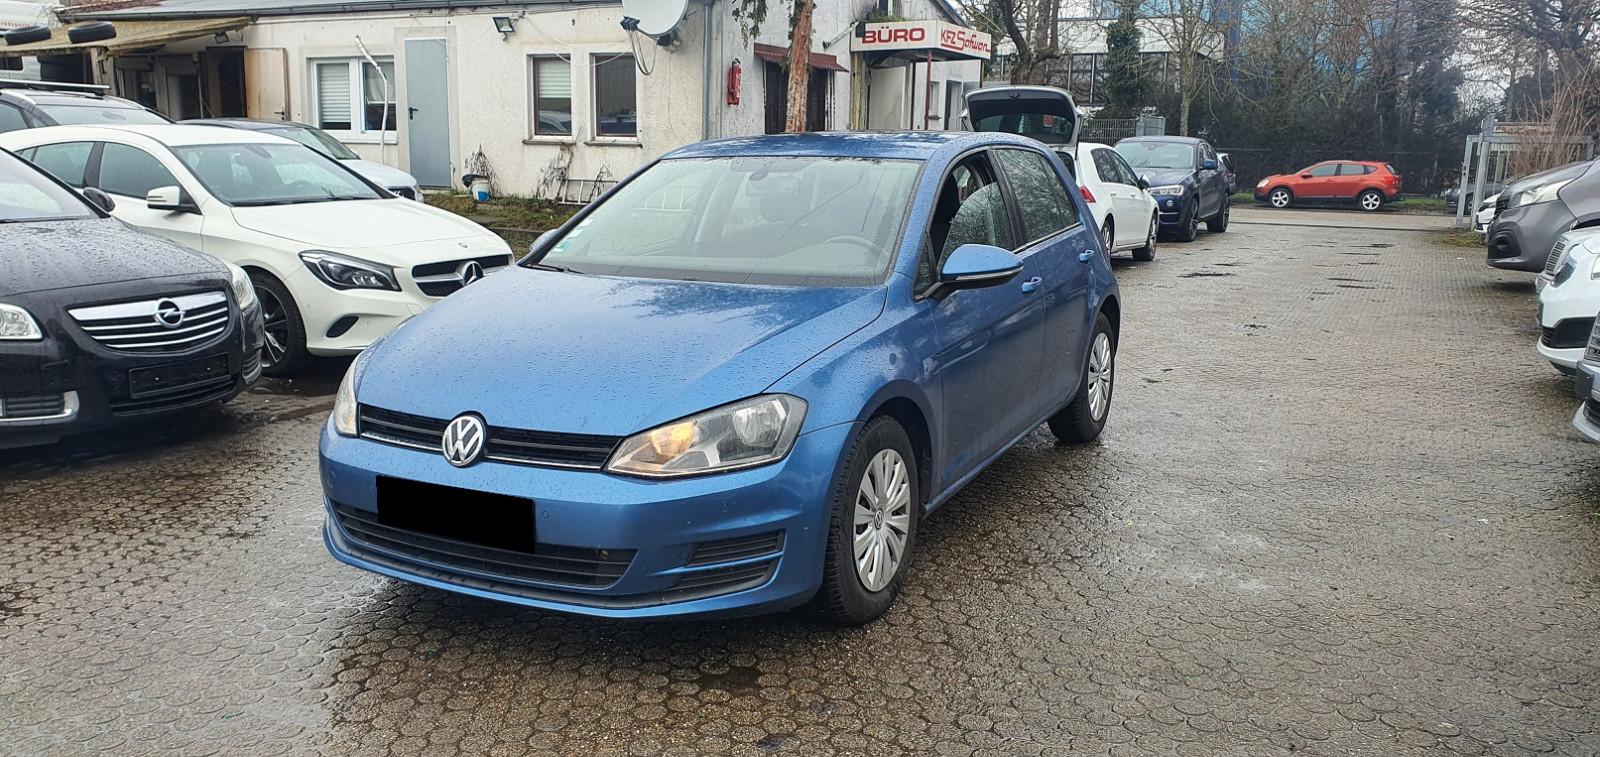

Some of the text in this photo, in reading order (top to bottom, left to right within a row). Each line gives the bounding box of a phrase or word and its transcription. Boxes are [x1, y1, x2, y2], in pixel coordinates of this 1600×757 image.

[862, 26, 925, 43] BÜRO
[941, 29, 956, 44] KFZ
[443, 415, 484, 466] VW
